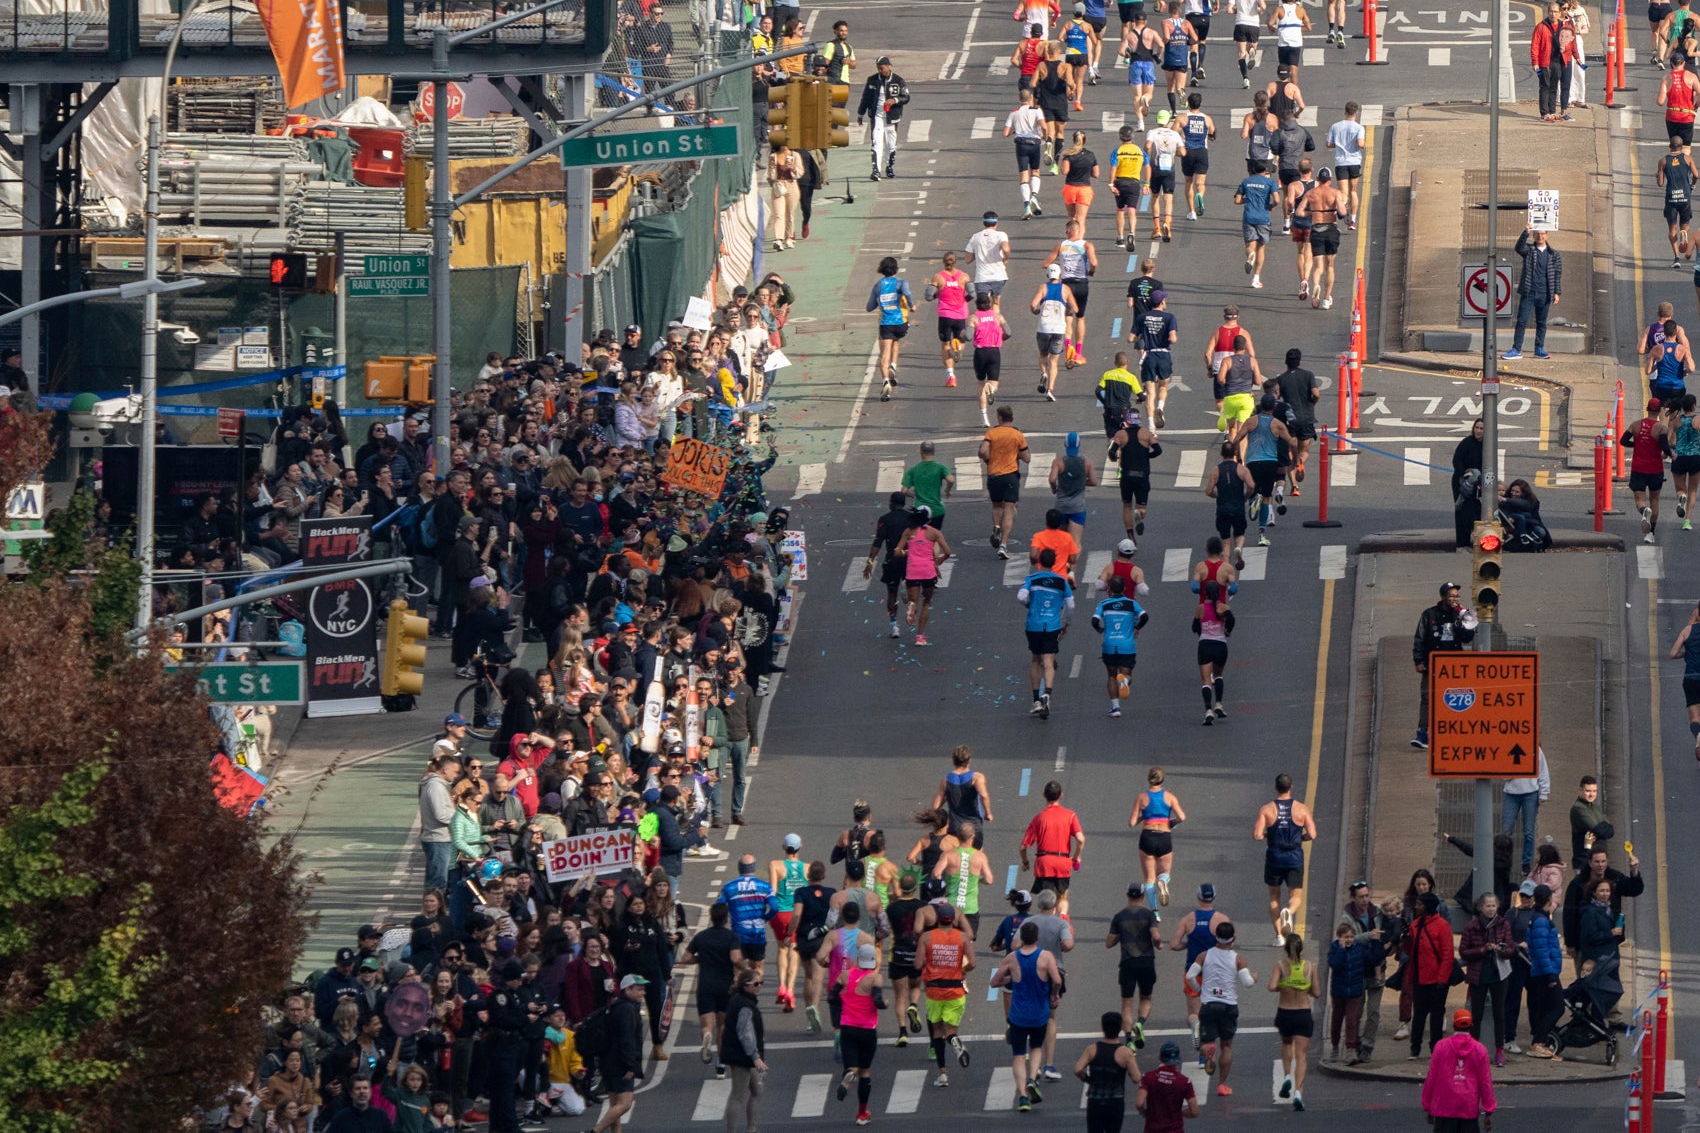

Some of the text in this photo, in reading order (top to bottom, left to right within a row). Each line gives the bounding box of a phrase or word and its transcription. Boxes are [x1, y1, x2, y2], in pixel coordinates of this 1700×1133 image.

[595, 134, 705, 160] Union St
[369, 257, 425, 273] Union St
[352, 278, 429, 290] RAUL VASQUEZ JR.
[310, 526, 360, 538] BlackMen
[326, 619, 357, 633] NYC
[315, 654, 366, 666] BlackMen
[313, 661, 364, 686] run
[1438, 665, 1533, 680] ALT ROUTE
[238, 672, 273, 695] St
[1448, 692, 1526, 707] 278 EAST
[1440, 746, 1501, 761] EXPWY
[554, 832, 632, 856] DUNCAN
[551, 850, 608, 872] DOIN'
[614, 847, 632, 860] IT
[737, 880, 757, 891] ITA
